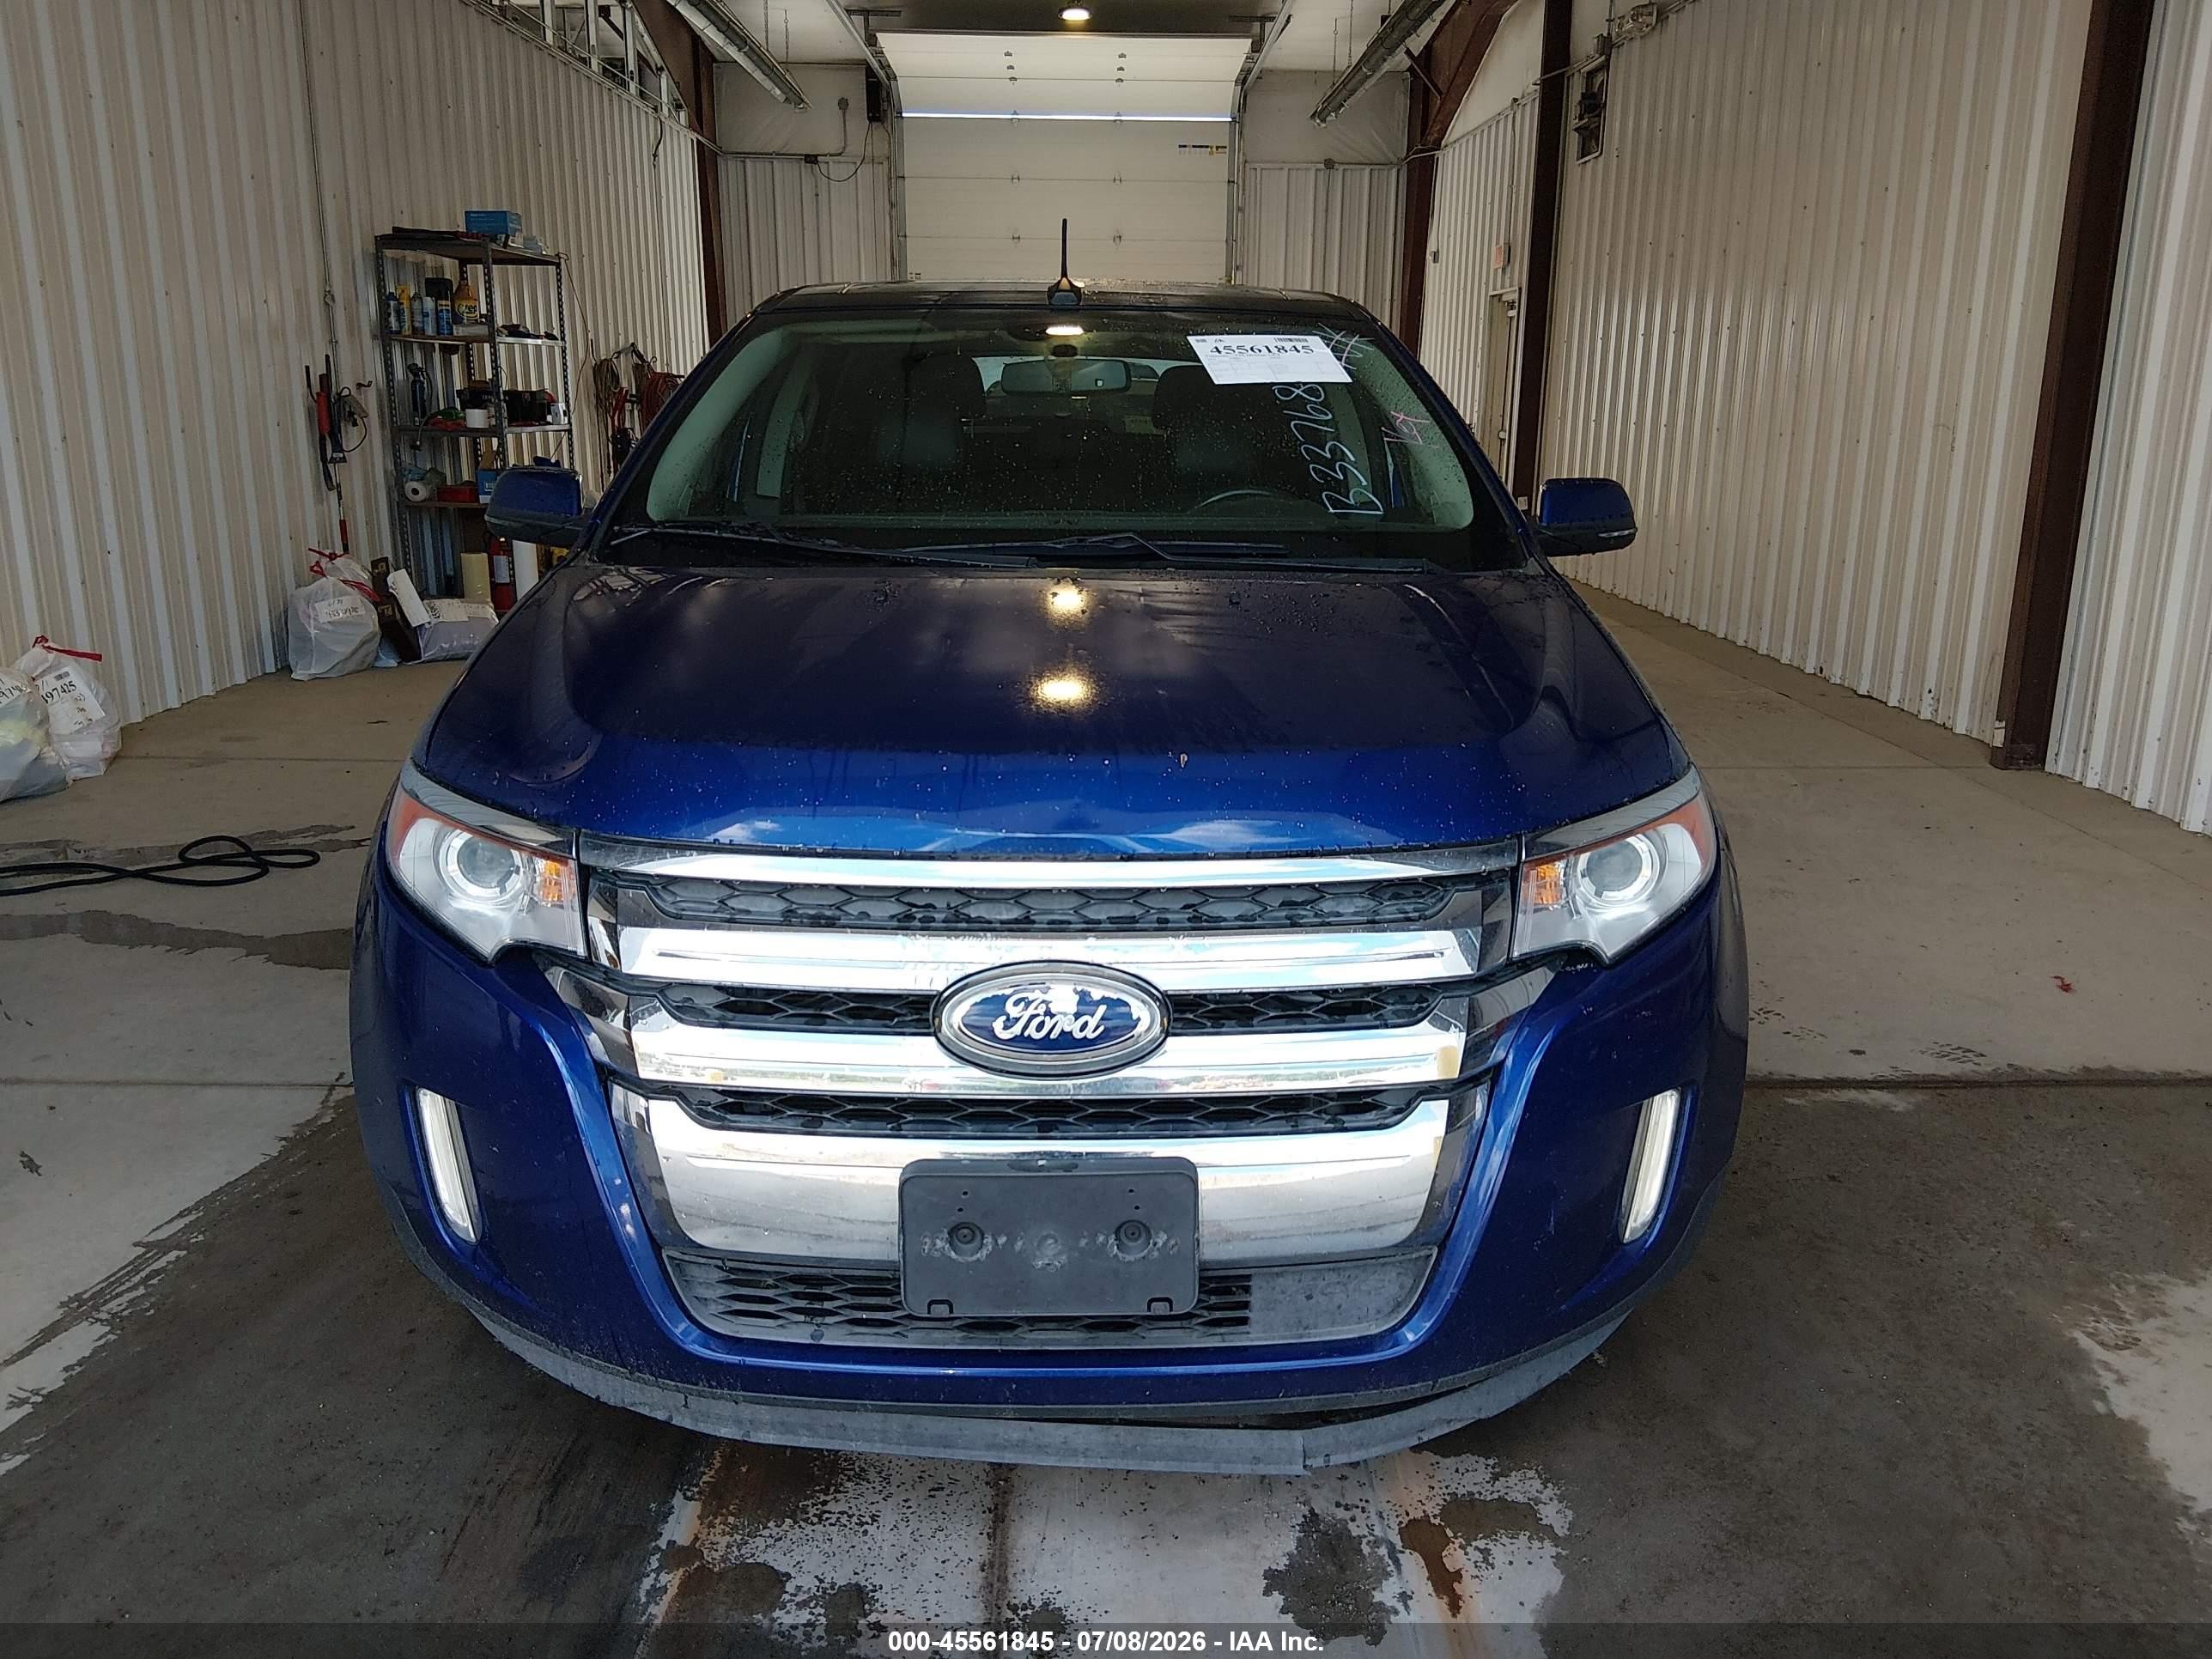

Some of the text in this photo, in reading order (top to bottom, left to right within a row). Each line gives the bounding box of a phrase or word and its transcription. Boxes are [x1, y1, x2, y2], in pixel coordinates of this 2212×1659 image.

[1210, 344, 1315, 356] 45561845
[1272, 383, 1384, 515] B33768
[992, 990, 1108, 1040] Ford
